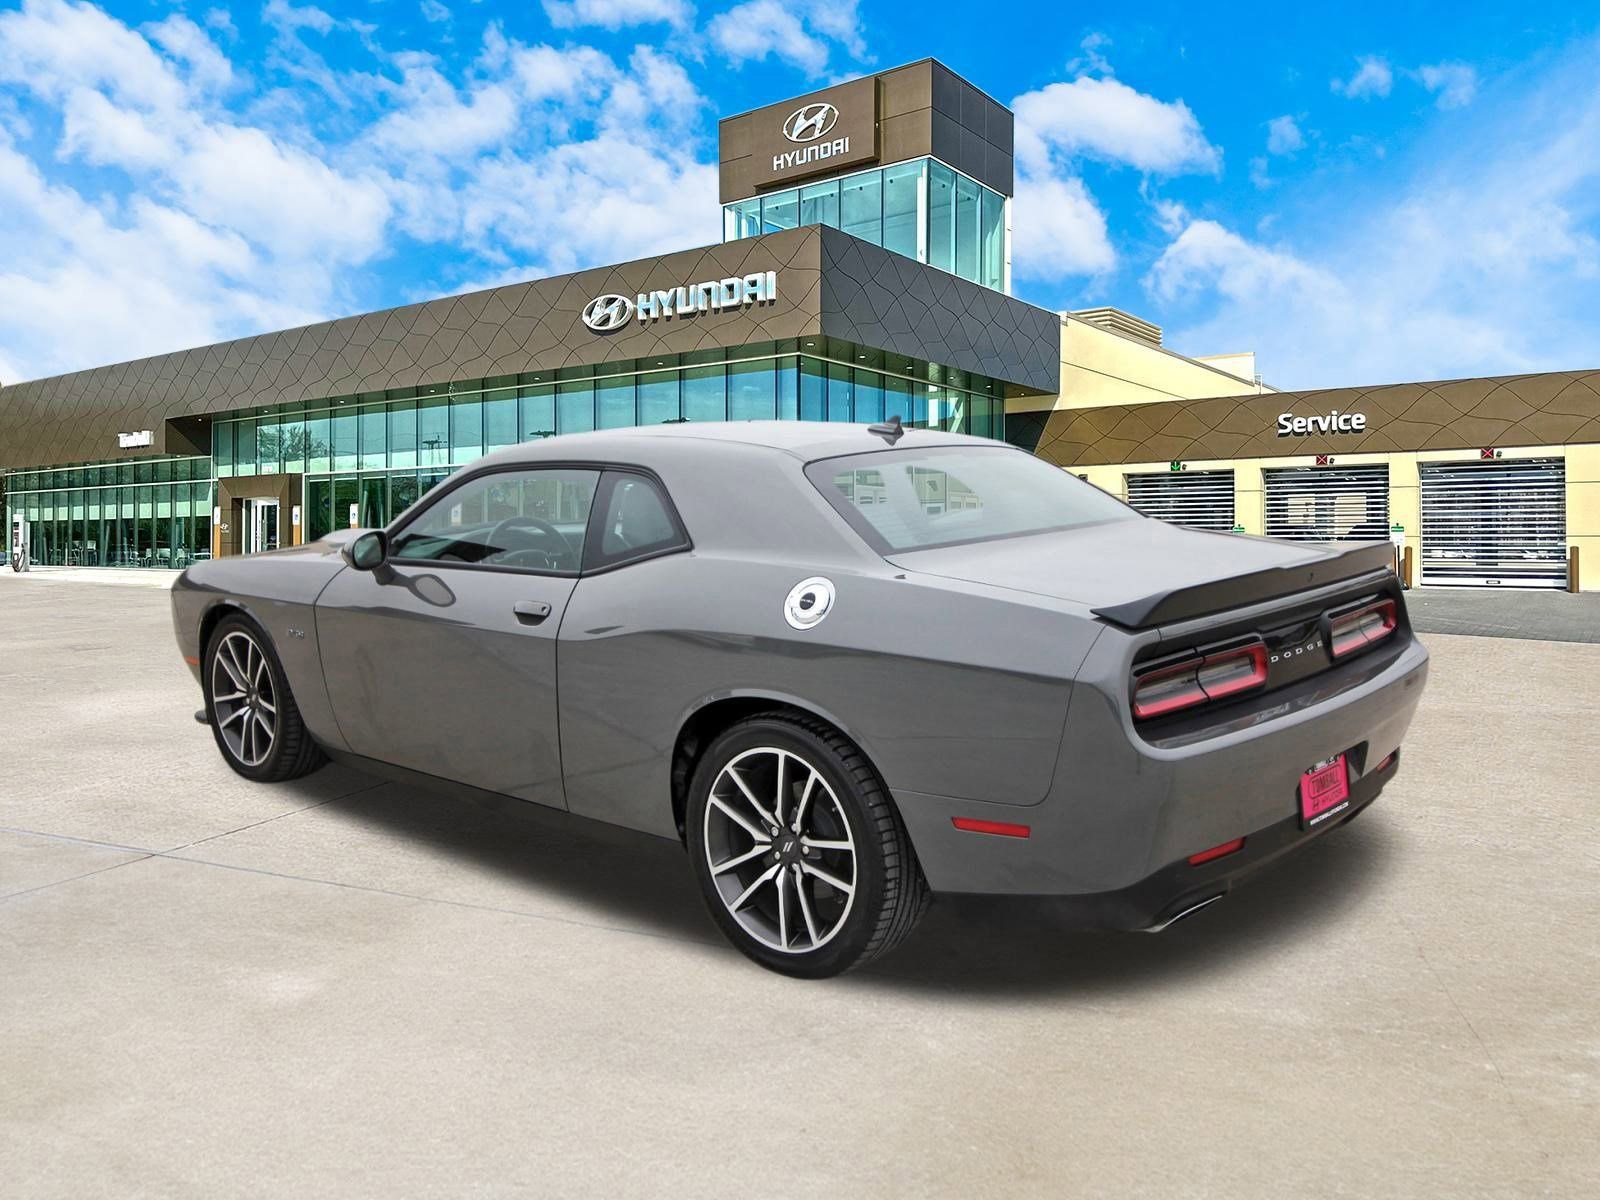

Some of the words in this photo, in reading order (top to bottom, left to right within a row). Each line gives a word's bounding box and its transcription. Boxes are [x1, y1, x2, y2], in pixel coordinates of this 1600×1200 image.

[773, 137, 849, 171] HYUNDAI
[637, 271, 777, 320] HYUNDAI
[1278, 410, 1366, 434] Service
[1271, 640, 1323, 663] DODGE
